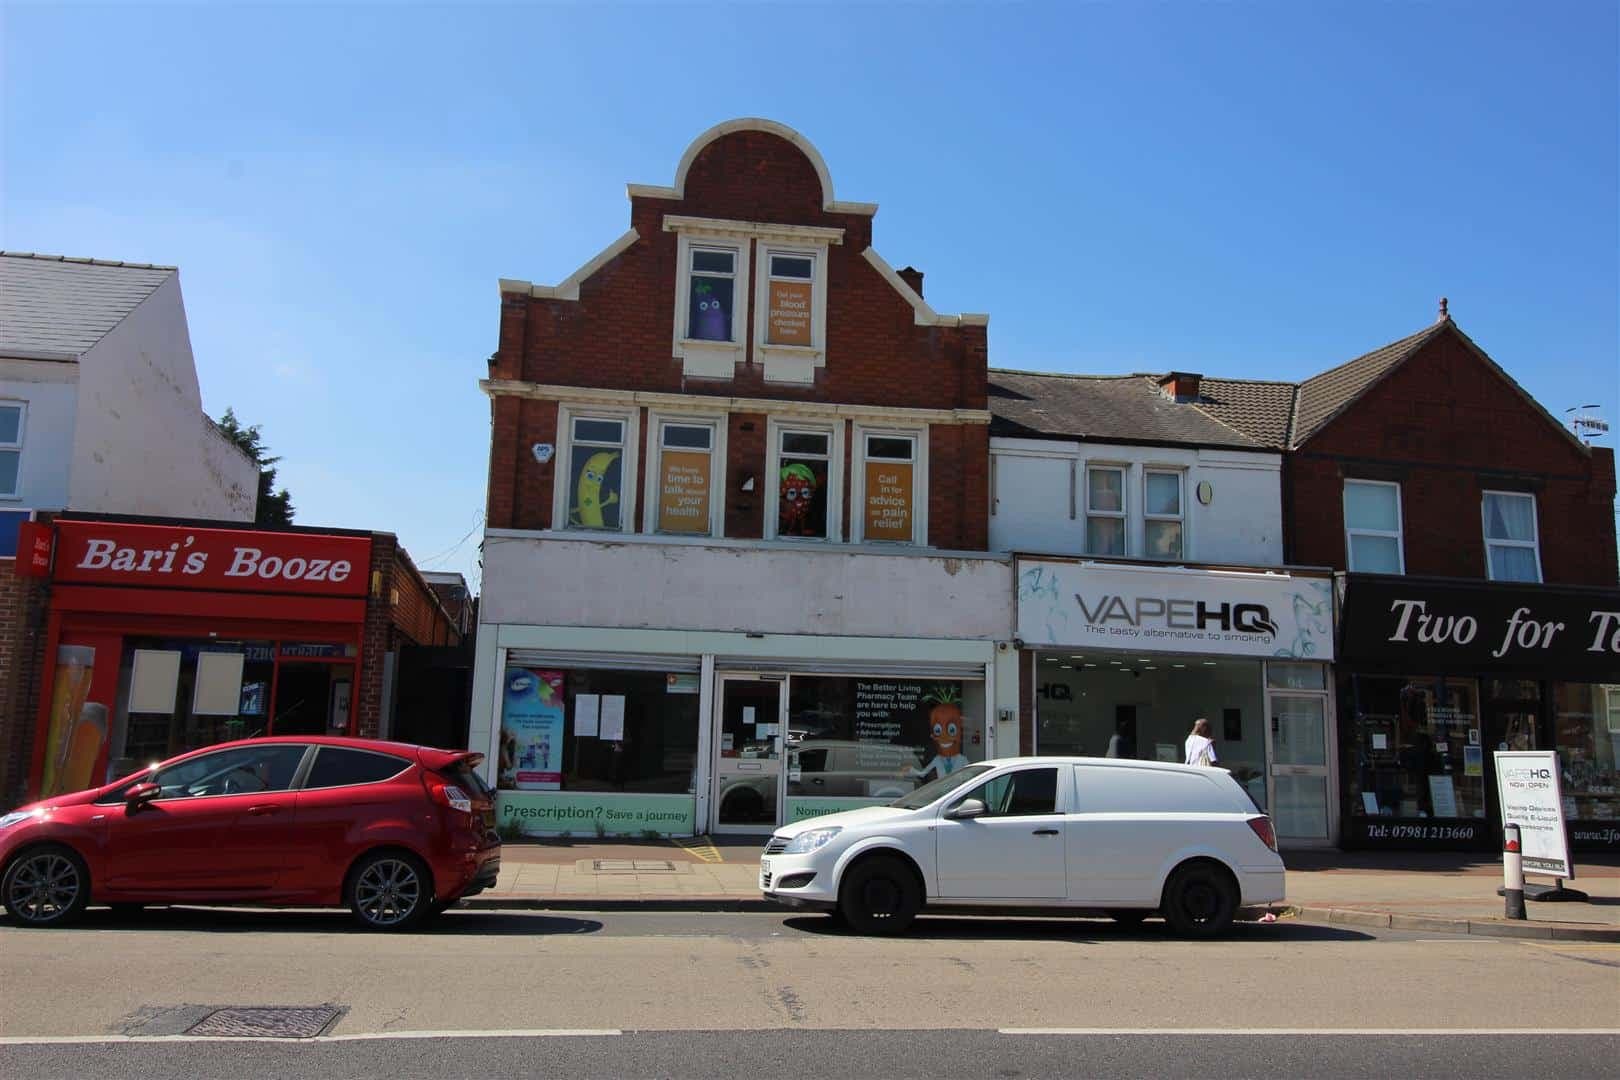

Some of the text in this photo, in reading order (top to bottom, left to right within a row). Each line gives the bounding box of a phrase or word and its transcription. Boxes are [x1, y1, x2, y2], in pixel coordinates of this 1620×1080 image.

[667, 472, 704, 485] time to
[878, 474, 897, 484] Call
[664, 485, 685, 494] talk
[678, 496, 703, 506] your
[870, 495, 905, 505] advice
[882, 507, 908, 519] pain
[873, 518, 904, 528] relief
[77, 536, 351, 582] Bari's Booze
[1075, 593, 1279, 640] VAPEHQ
[1388, 599, 1478, 645] Two
[1492, 607, 1566, 658] for
[1084, 624, 1271, 645] The tasty alternative to smoking
[857, 682, 922, 694] The Better Living
[856, 692, 895, 701] Pharmacy
[899, 702, 917, 710] help
[856, 711, 871, 719] you
[1527, 782, 1549, 790] OPEN
[504, 804, 688, 823] Prescription? Save a journey
[796, 807, 849, 817] Nominat
[1368, 824, 1474, 839] Tel: 07981 213660
